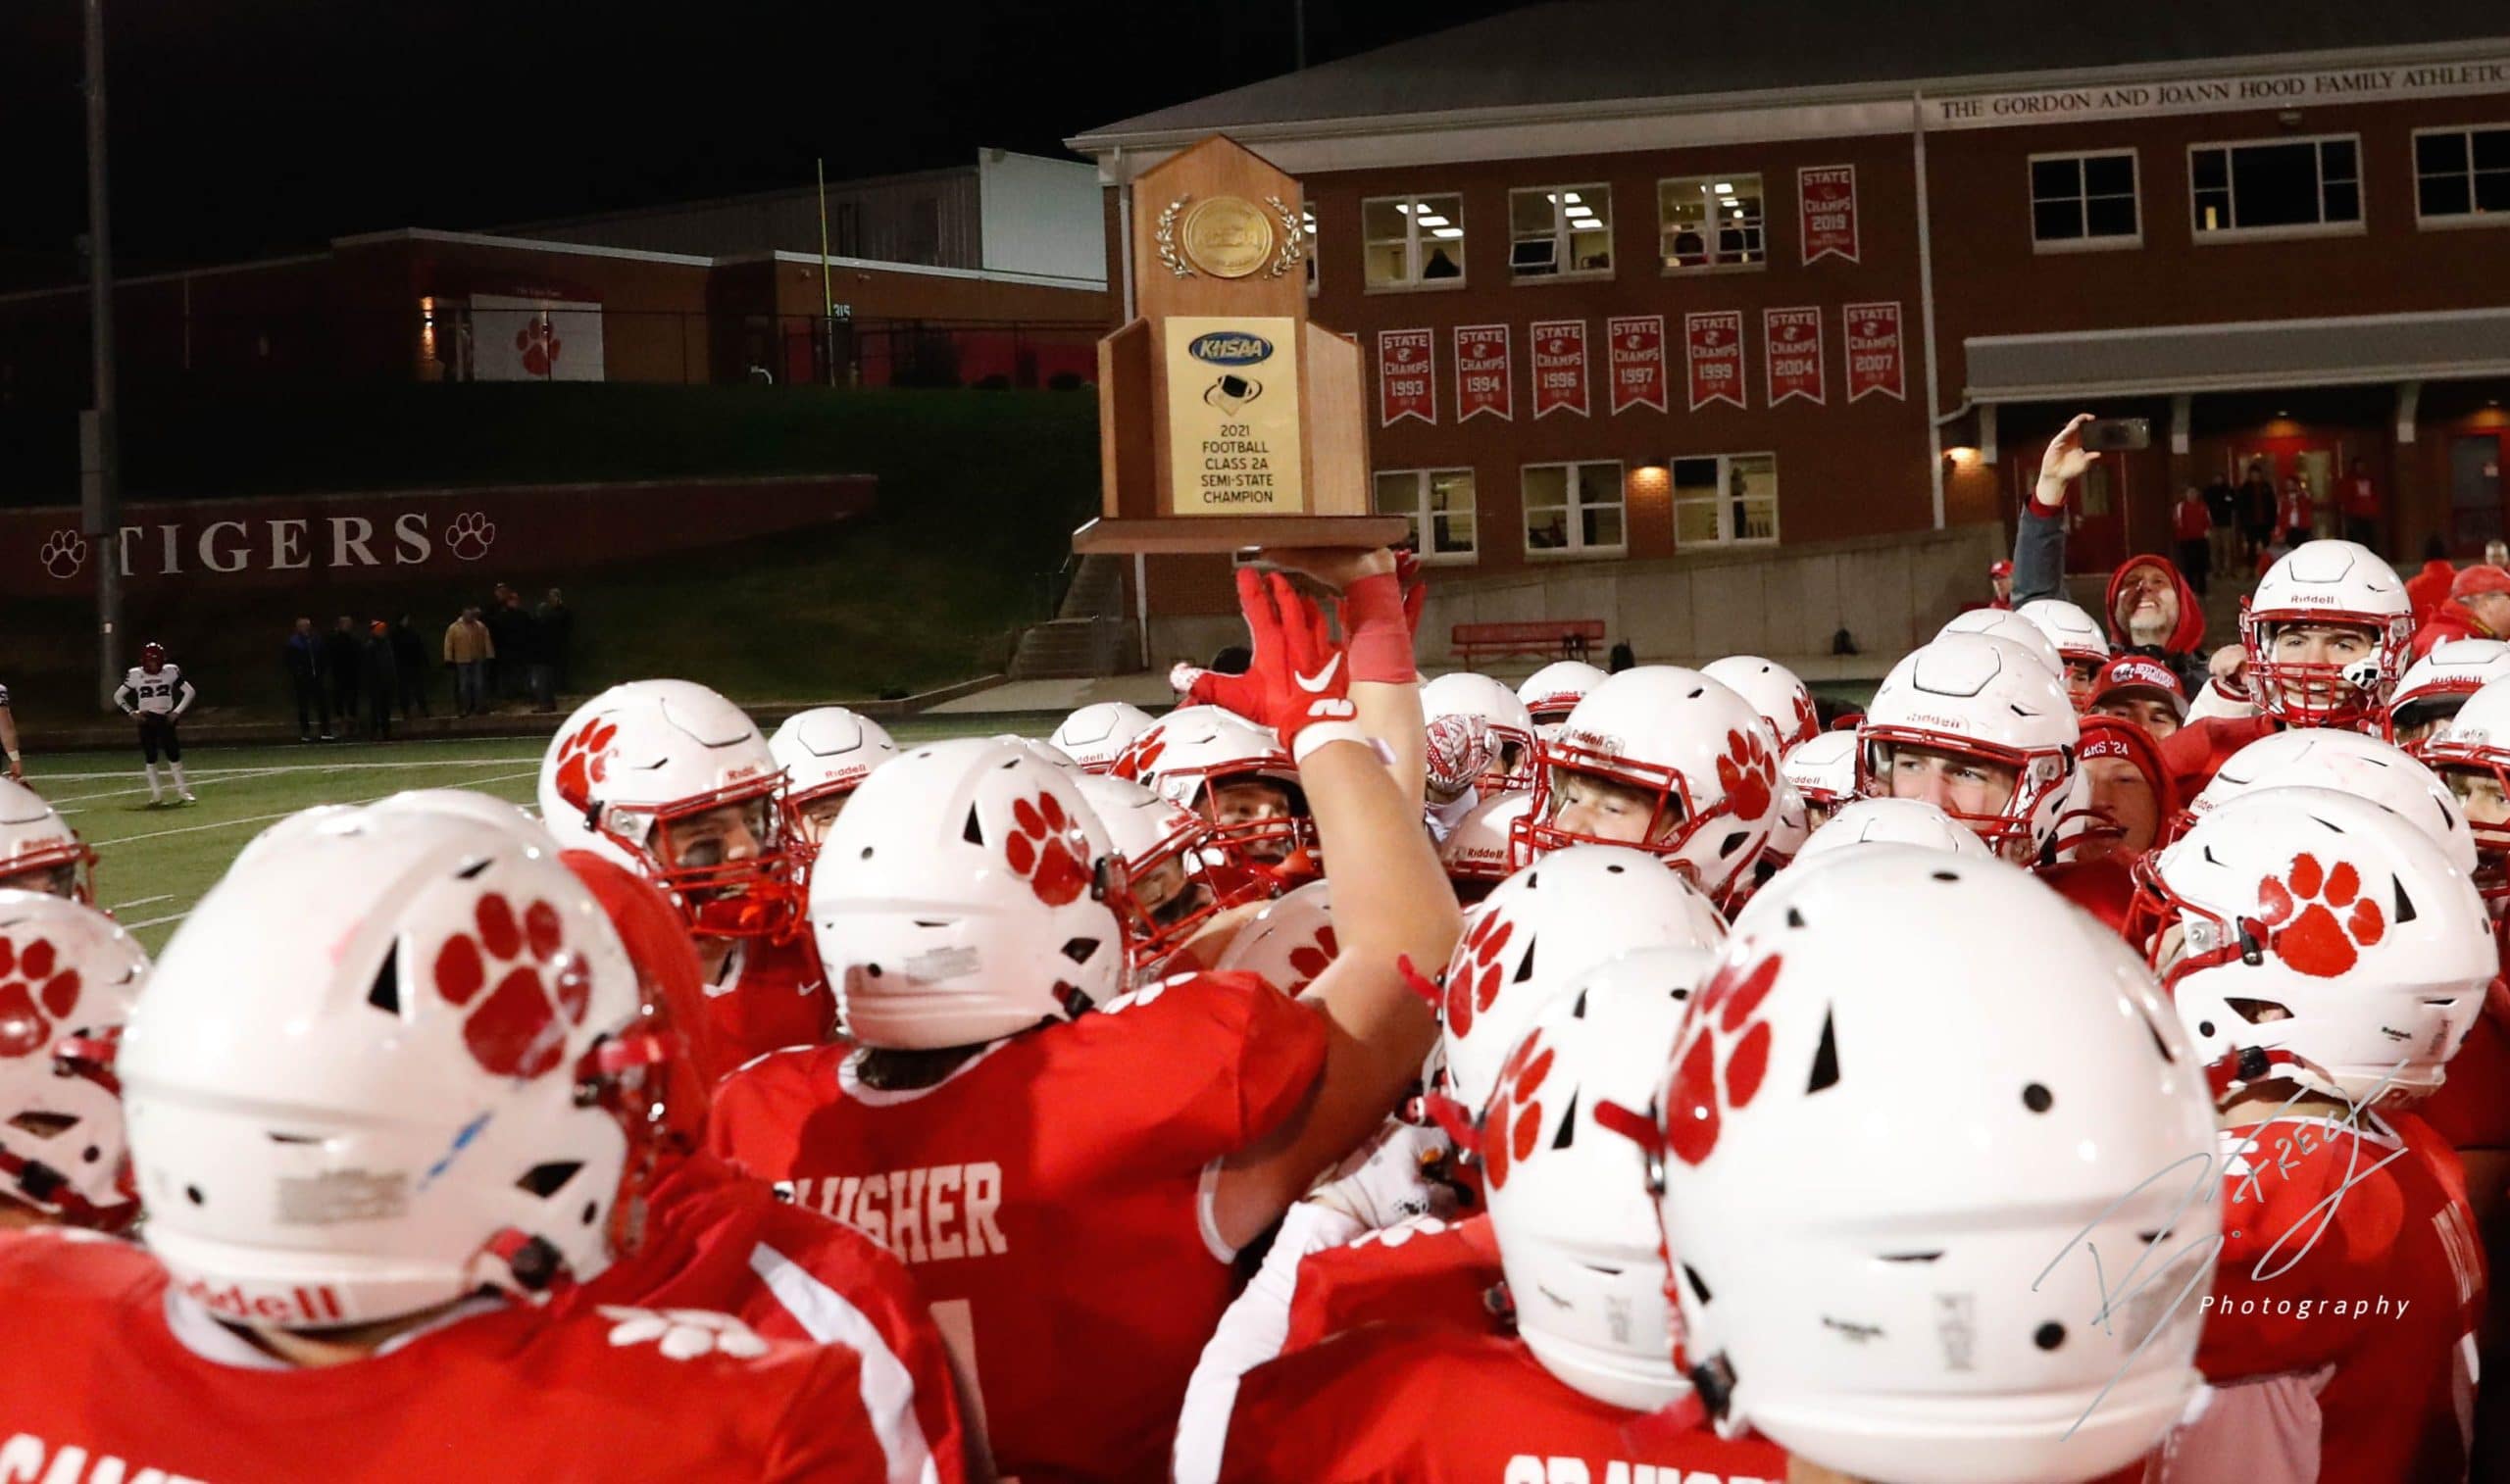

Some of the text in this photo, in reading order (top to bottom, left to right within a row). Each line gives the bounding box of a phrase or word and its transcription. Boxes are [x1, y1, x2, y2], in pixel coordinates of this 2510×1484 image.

[1940, 101, 1983, 119] THE
[1993, 93, 2090, 115] GORDON
[2099, 88, 2149, 108] AND
[2157, 83, 2229, 106] JOANN
[2239, 78, 2304, 98] HOOD
[2315, 71, 2395, 93] FAMILY
[1804, 172, 1850, 186] STATE
[1805, 196, 1851, 213] CHAMPS
[1812, 214, 1846, 231] 2019
[1769, 313, 1815, 327] STATE
[1848, 308, 1894, 322] STATE
[1535, 324, 1581, 340] STATE
[1613, 322, 1658, 336] STATE
[1690, 317, 1736, 331] STATE
[1383, 334, 1429, 349] STATE
[1459, 329, 1504, 344] STATE
[1850, 334, 1896, 350] CHAMPS
[1199, 339, 1264, 360] KHSAA
[1692, 343, 1738, 359] CHAMPS
[1770, 339, 1817, 355] CHAMPS
[1460, 355, 1505, 371] CHAMPS
[1536, 352, 1581, 368] CHAMPS
[1614, 348, 1659, 363] CHAMPS
[1855, 355, 1893, 372] 2007
[1384, 360, 1429, 375] CHAMPS
[1699, 364, 1733, 380] 1999
[1775, 360, 1814, 376] 2004
[1467, 375, 1500, 392] 1994
[1543, 371, 1577, 389] 1996
[1621, 368, 1653, 384] 1997
[1391, 380, 1424, 397] 1993
[1221, 424, 1250, 437] 2021
[1202, 441, 1269, 454] FOOTBALL
[1205, 458, 1268, 470] CLASS 2A
[1201, 474, 1274, 487] SEMI-STATE
[1203, 491, 1273, 504] CHAMPION
[119, 512, 432, 576] TIGERS
[2290, 595, 2334, 604] Riddell
[140, 685, 170, 698] 22
[825, 764, 867, 778] Riddell
